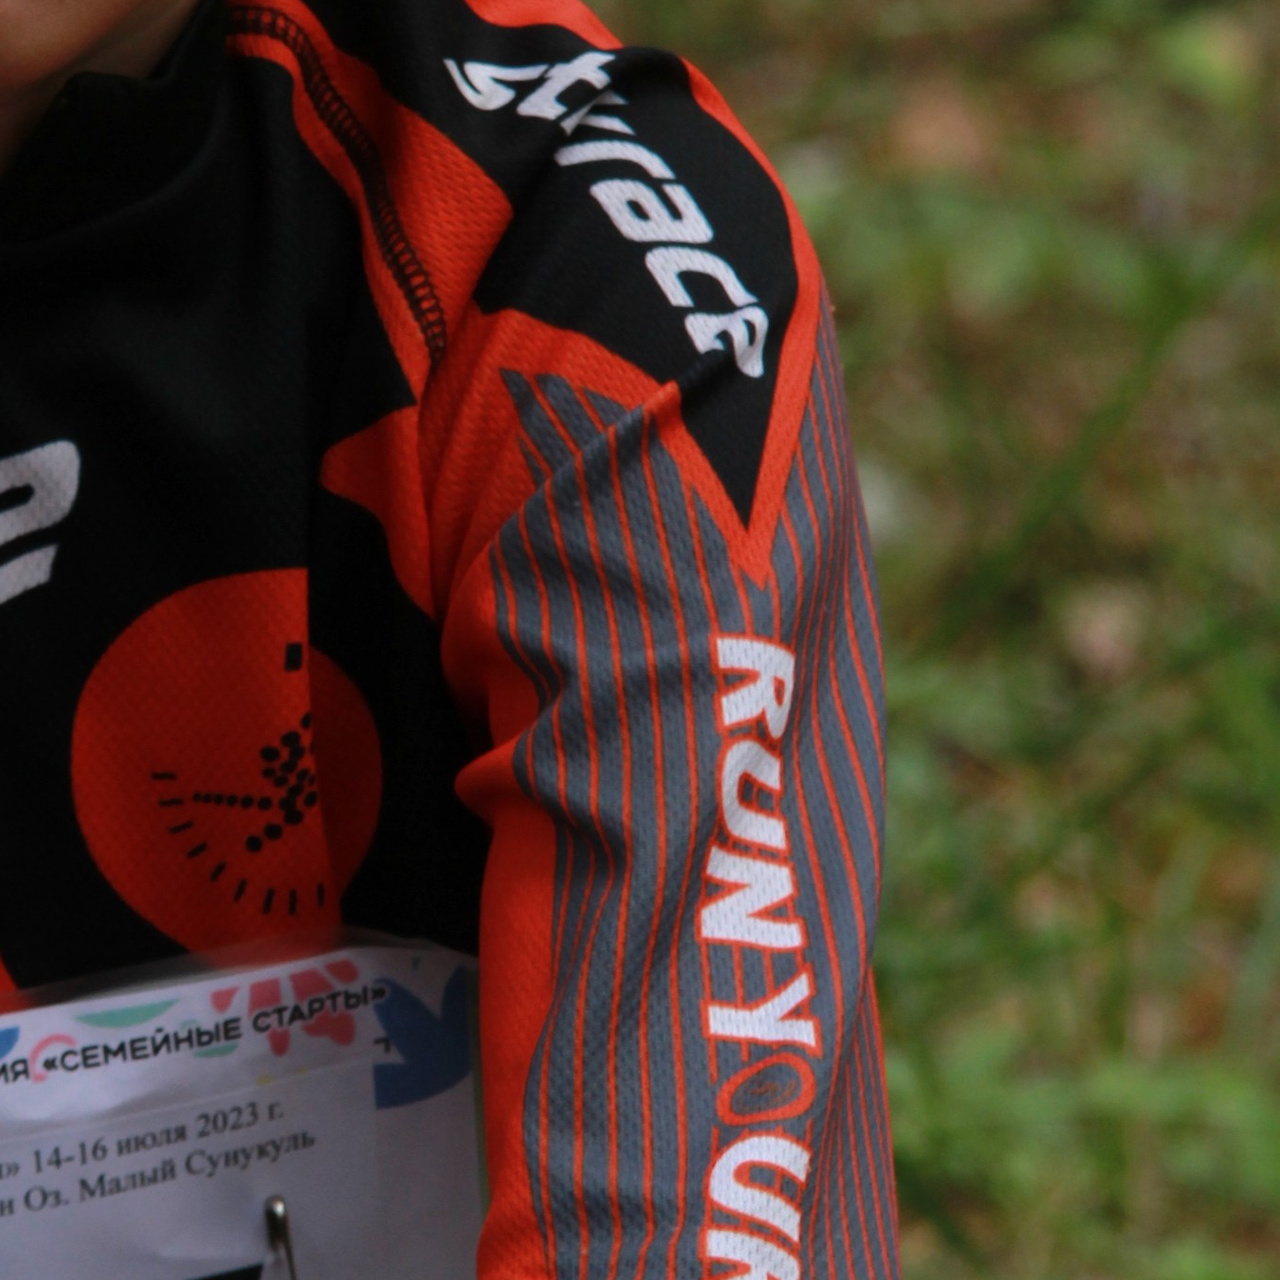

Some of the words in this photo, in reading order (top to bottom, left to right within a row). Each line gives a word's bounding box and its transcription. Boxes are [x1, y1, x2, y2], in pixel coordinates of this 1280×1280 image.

[696, 635, 805, 952] RUN
[43, 1019, 241, 1074] «СЕМЕЙНЫЕ
[252, 984, 387, 1034] СТАРТЫ»
[25, 1185, 69, 1212] Оз.
[78, 1160, 177, 1201] Малый
[185, 1127, 315, 1178] Сунукуль
[32, 1137, 107, 1174] 14-16
[116, 1124, 187, 1157] июля
[196, 1101, 260, 1139] 2023
